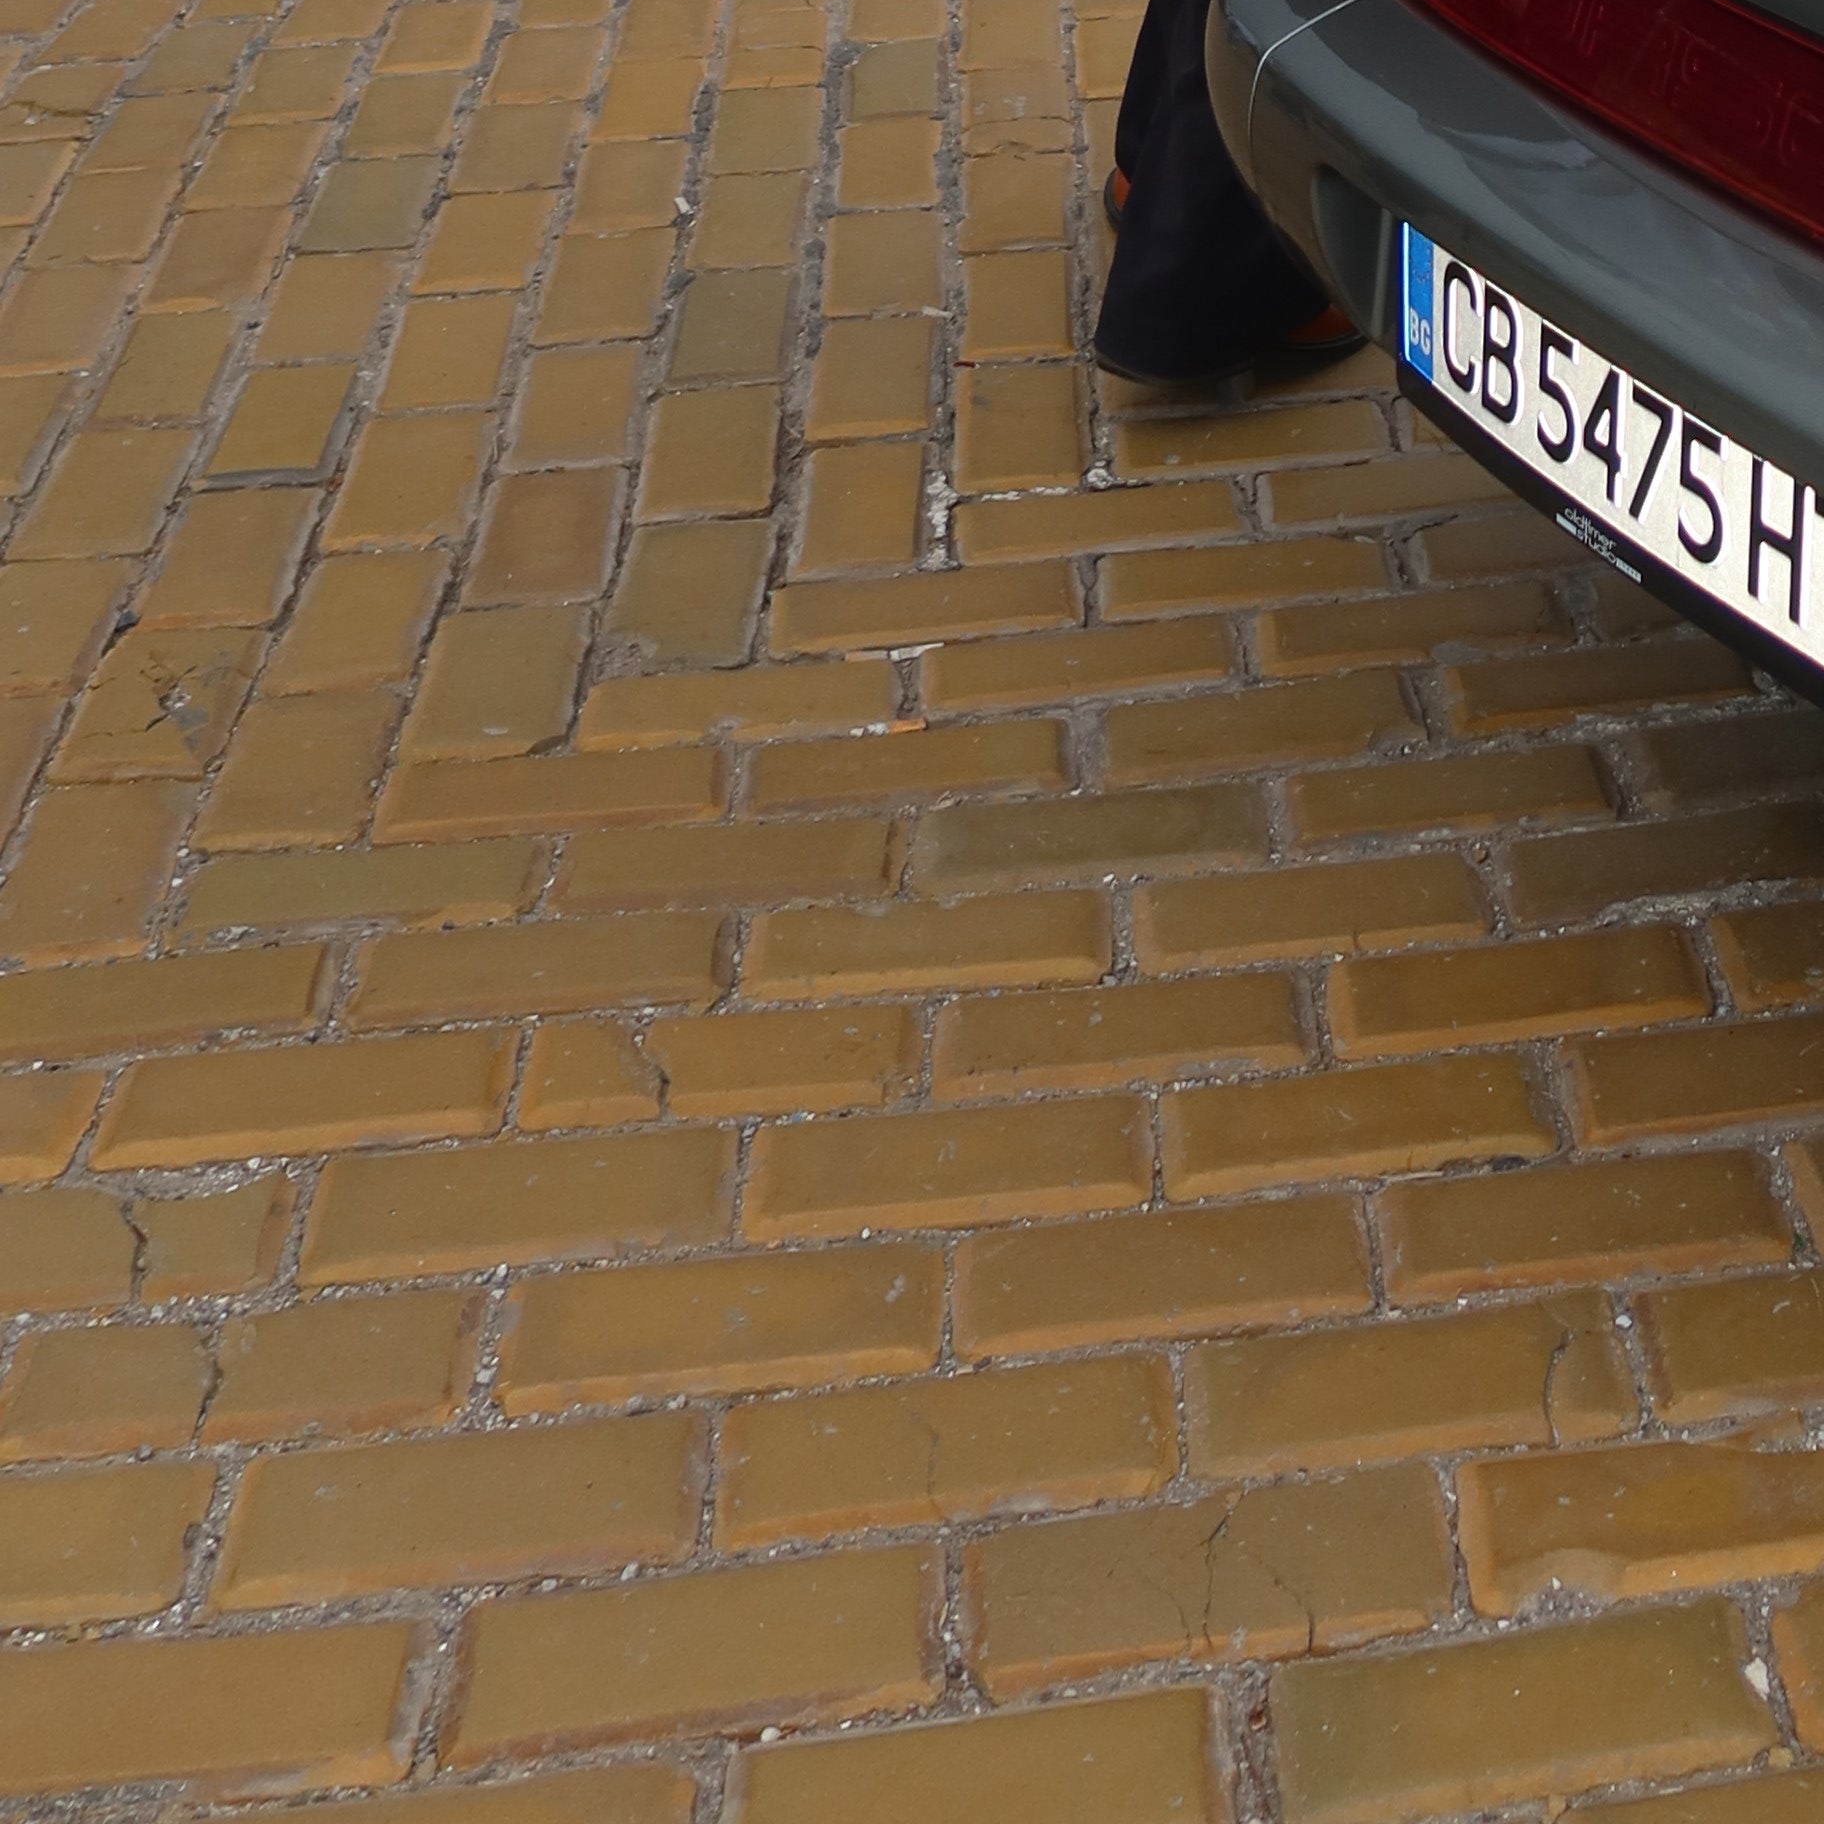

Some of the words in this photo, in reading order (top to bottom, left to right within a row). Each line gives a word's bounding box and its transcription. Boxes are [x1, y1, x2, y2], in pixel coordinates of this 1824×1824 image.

[1410, 307, 1431, 355] BG
[1443, 261, 1524, 426] CB
[1537, 319, 1731, 566] 5475
[1564, 508, 1617, 550] oldtimer
[1576, 524, 1616, 564] studio
